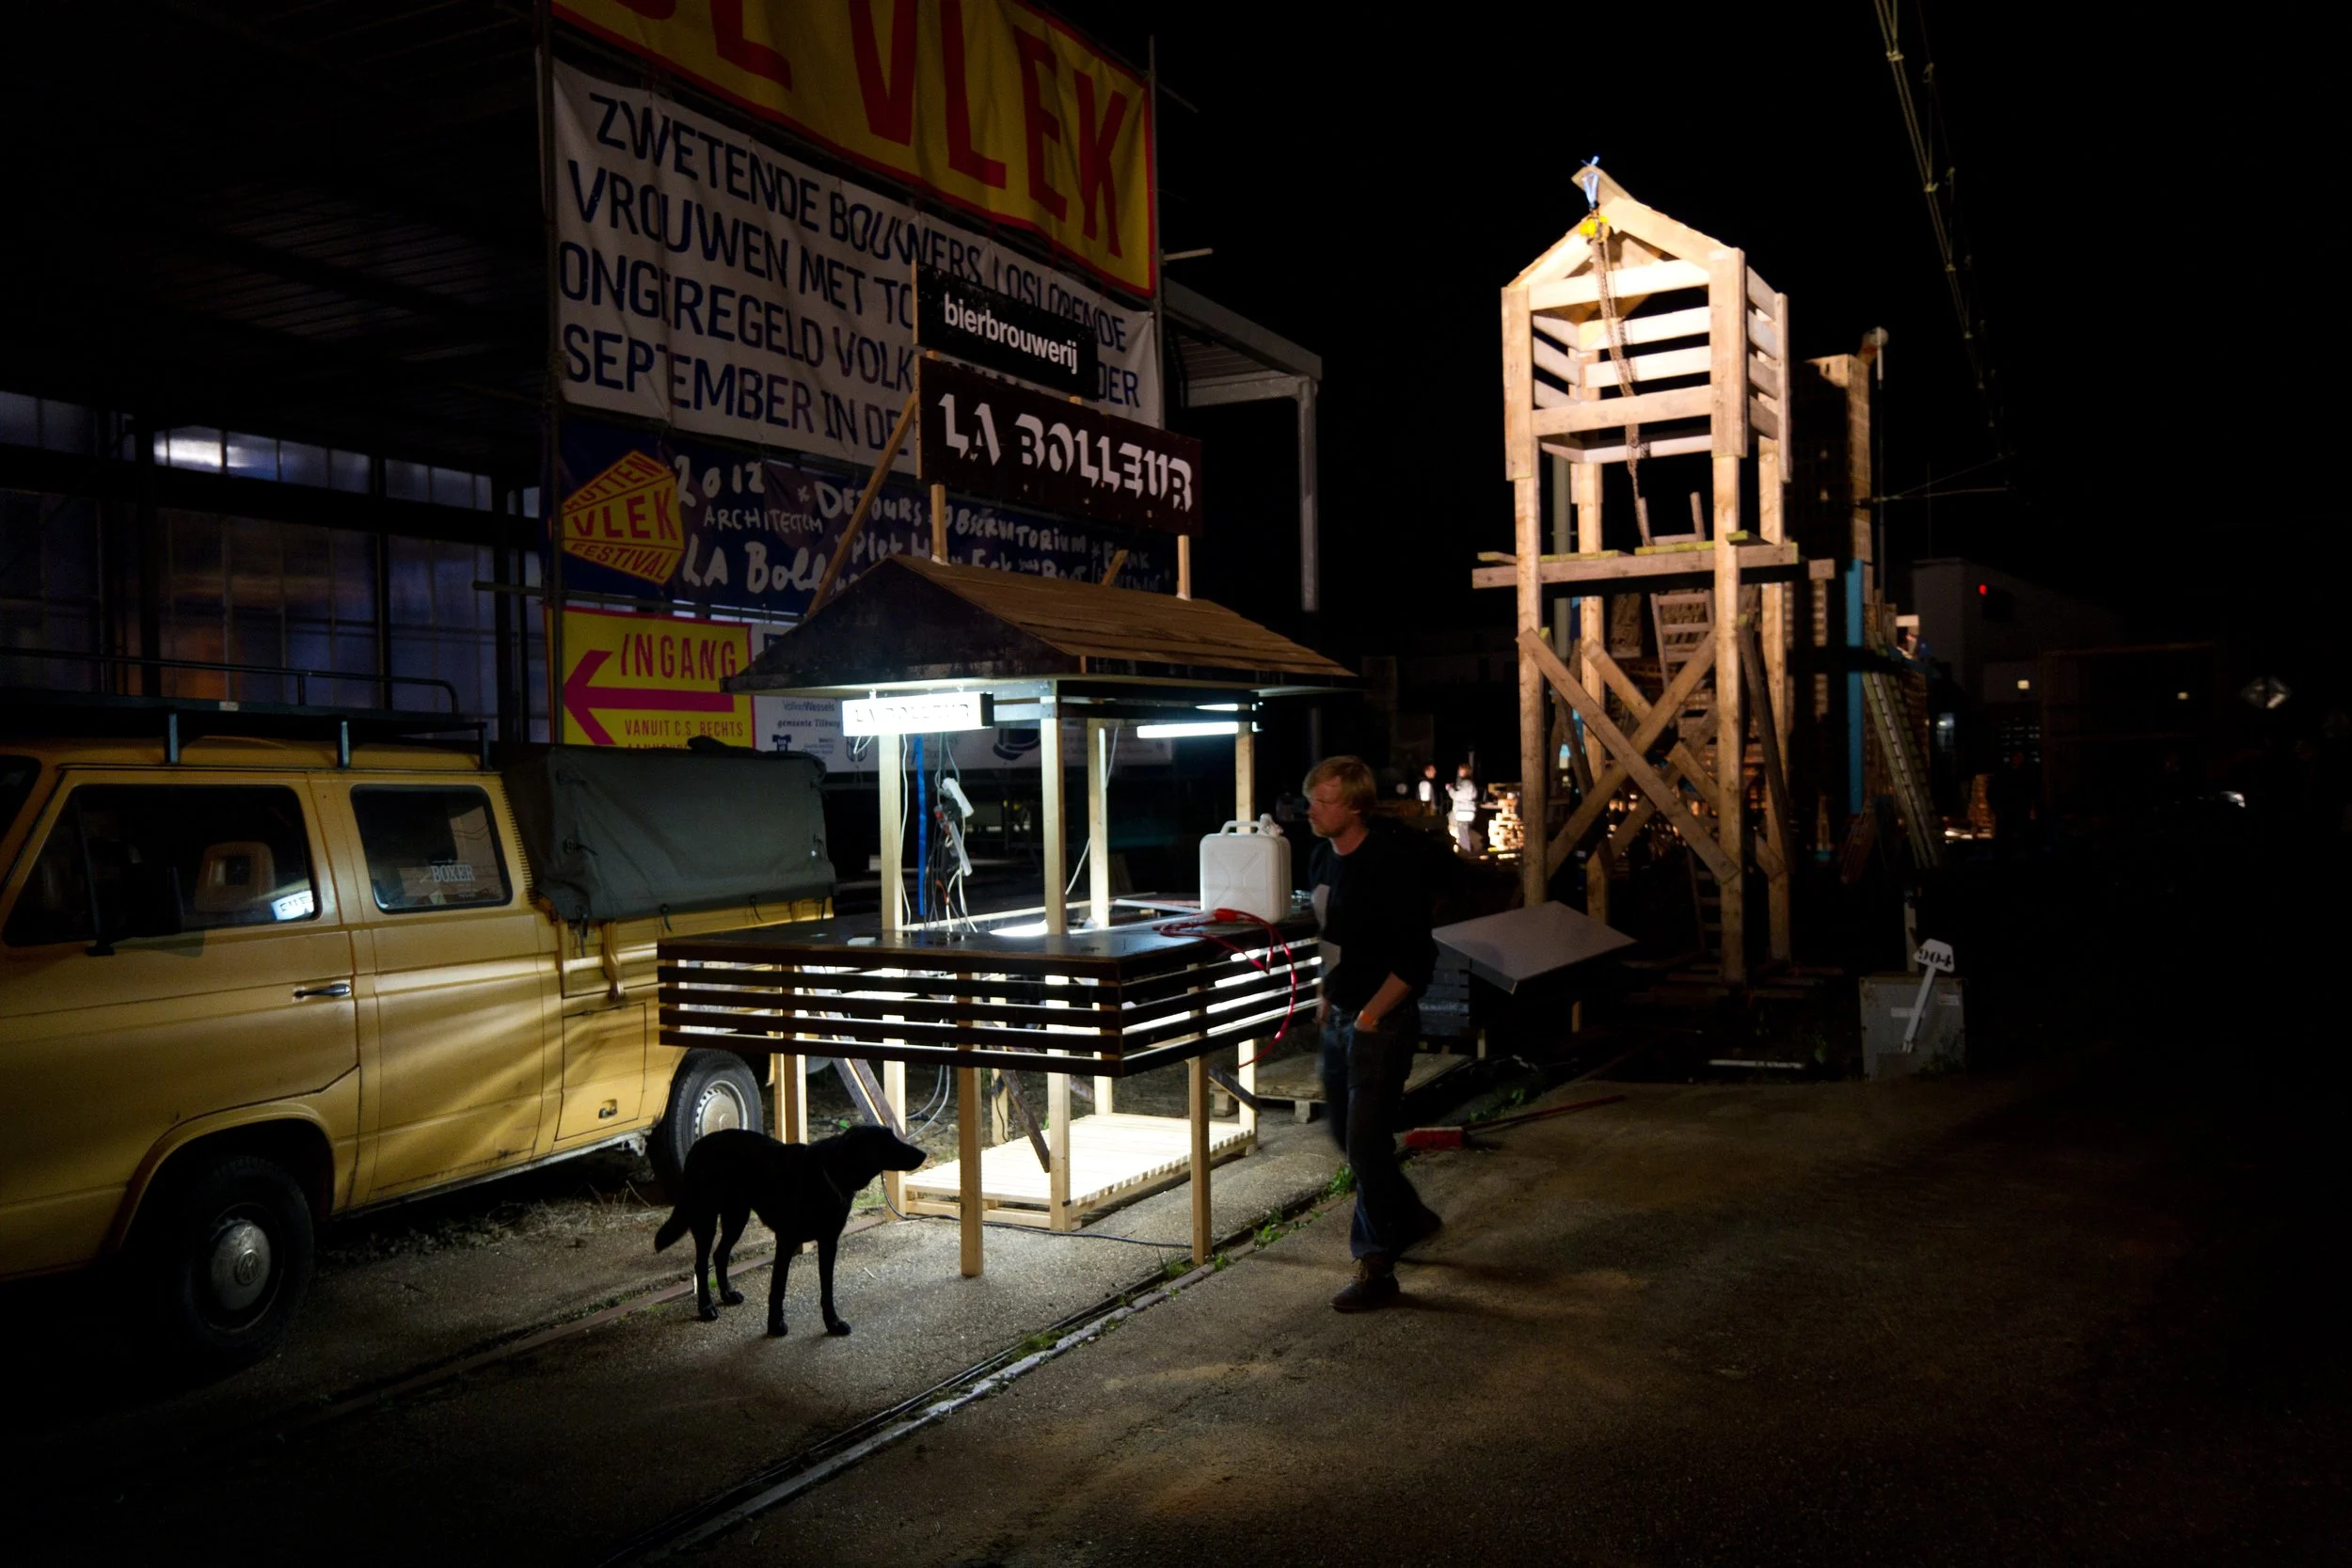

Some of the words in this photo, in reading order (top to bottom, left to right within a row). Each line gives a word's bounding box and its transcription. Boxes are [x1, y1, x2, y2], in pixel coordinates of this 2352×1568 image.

[848, 0, 1128, 258] VLEK
[589, 92, 820, 232] ZWETENDE
[567, 159, 788, 288] VROUWEN
[799, 245, 865, 315] MET
[833, 326, 914, 392] VOLK
[944, 291, 1078, 375] bierbrouwerij
[820, 390, 858, 445] IN
[937, 392, 1002, 467] LA
[1014, 412, 1194, 513] BOLLEUR
[571, 486, 678, 541] VLEK
[814, 481, 923, 528] DEOURS
[570, 542, 675, 580] FESTIVAL
[681, 532, 729, 588] LA
[621, 632, 737, 681] INGANG
[624, 719, 670, 736] VANUIT
[699, 721, 744, 737] RECHTS
[430, 864, 475, 882] BOXER
